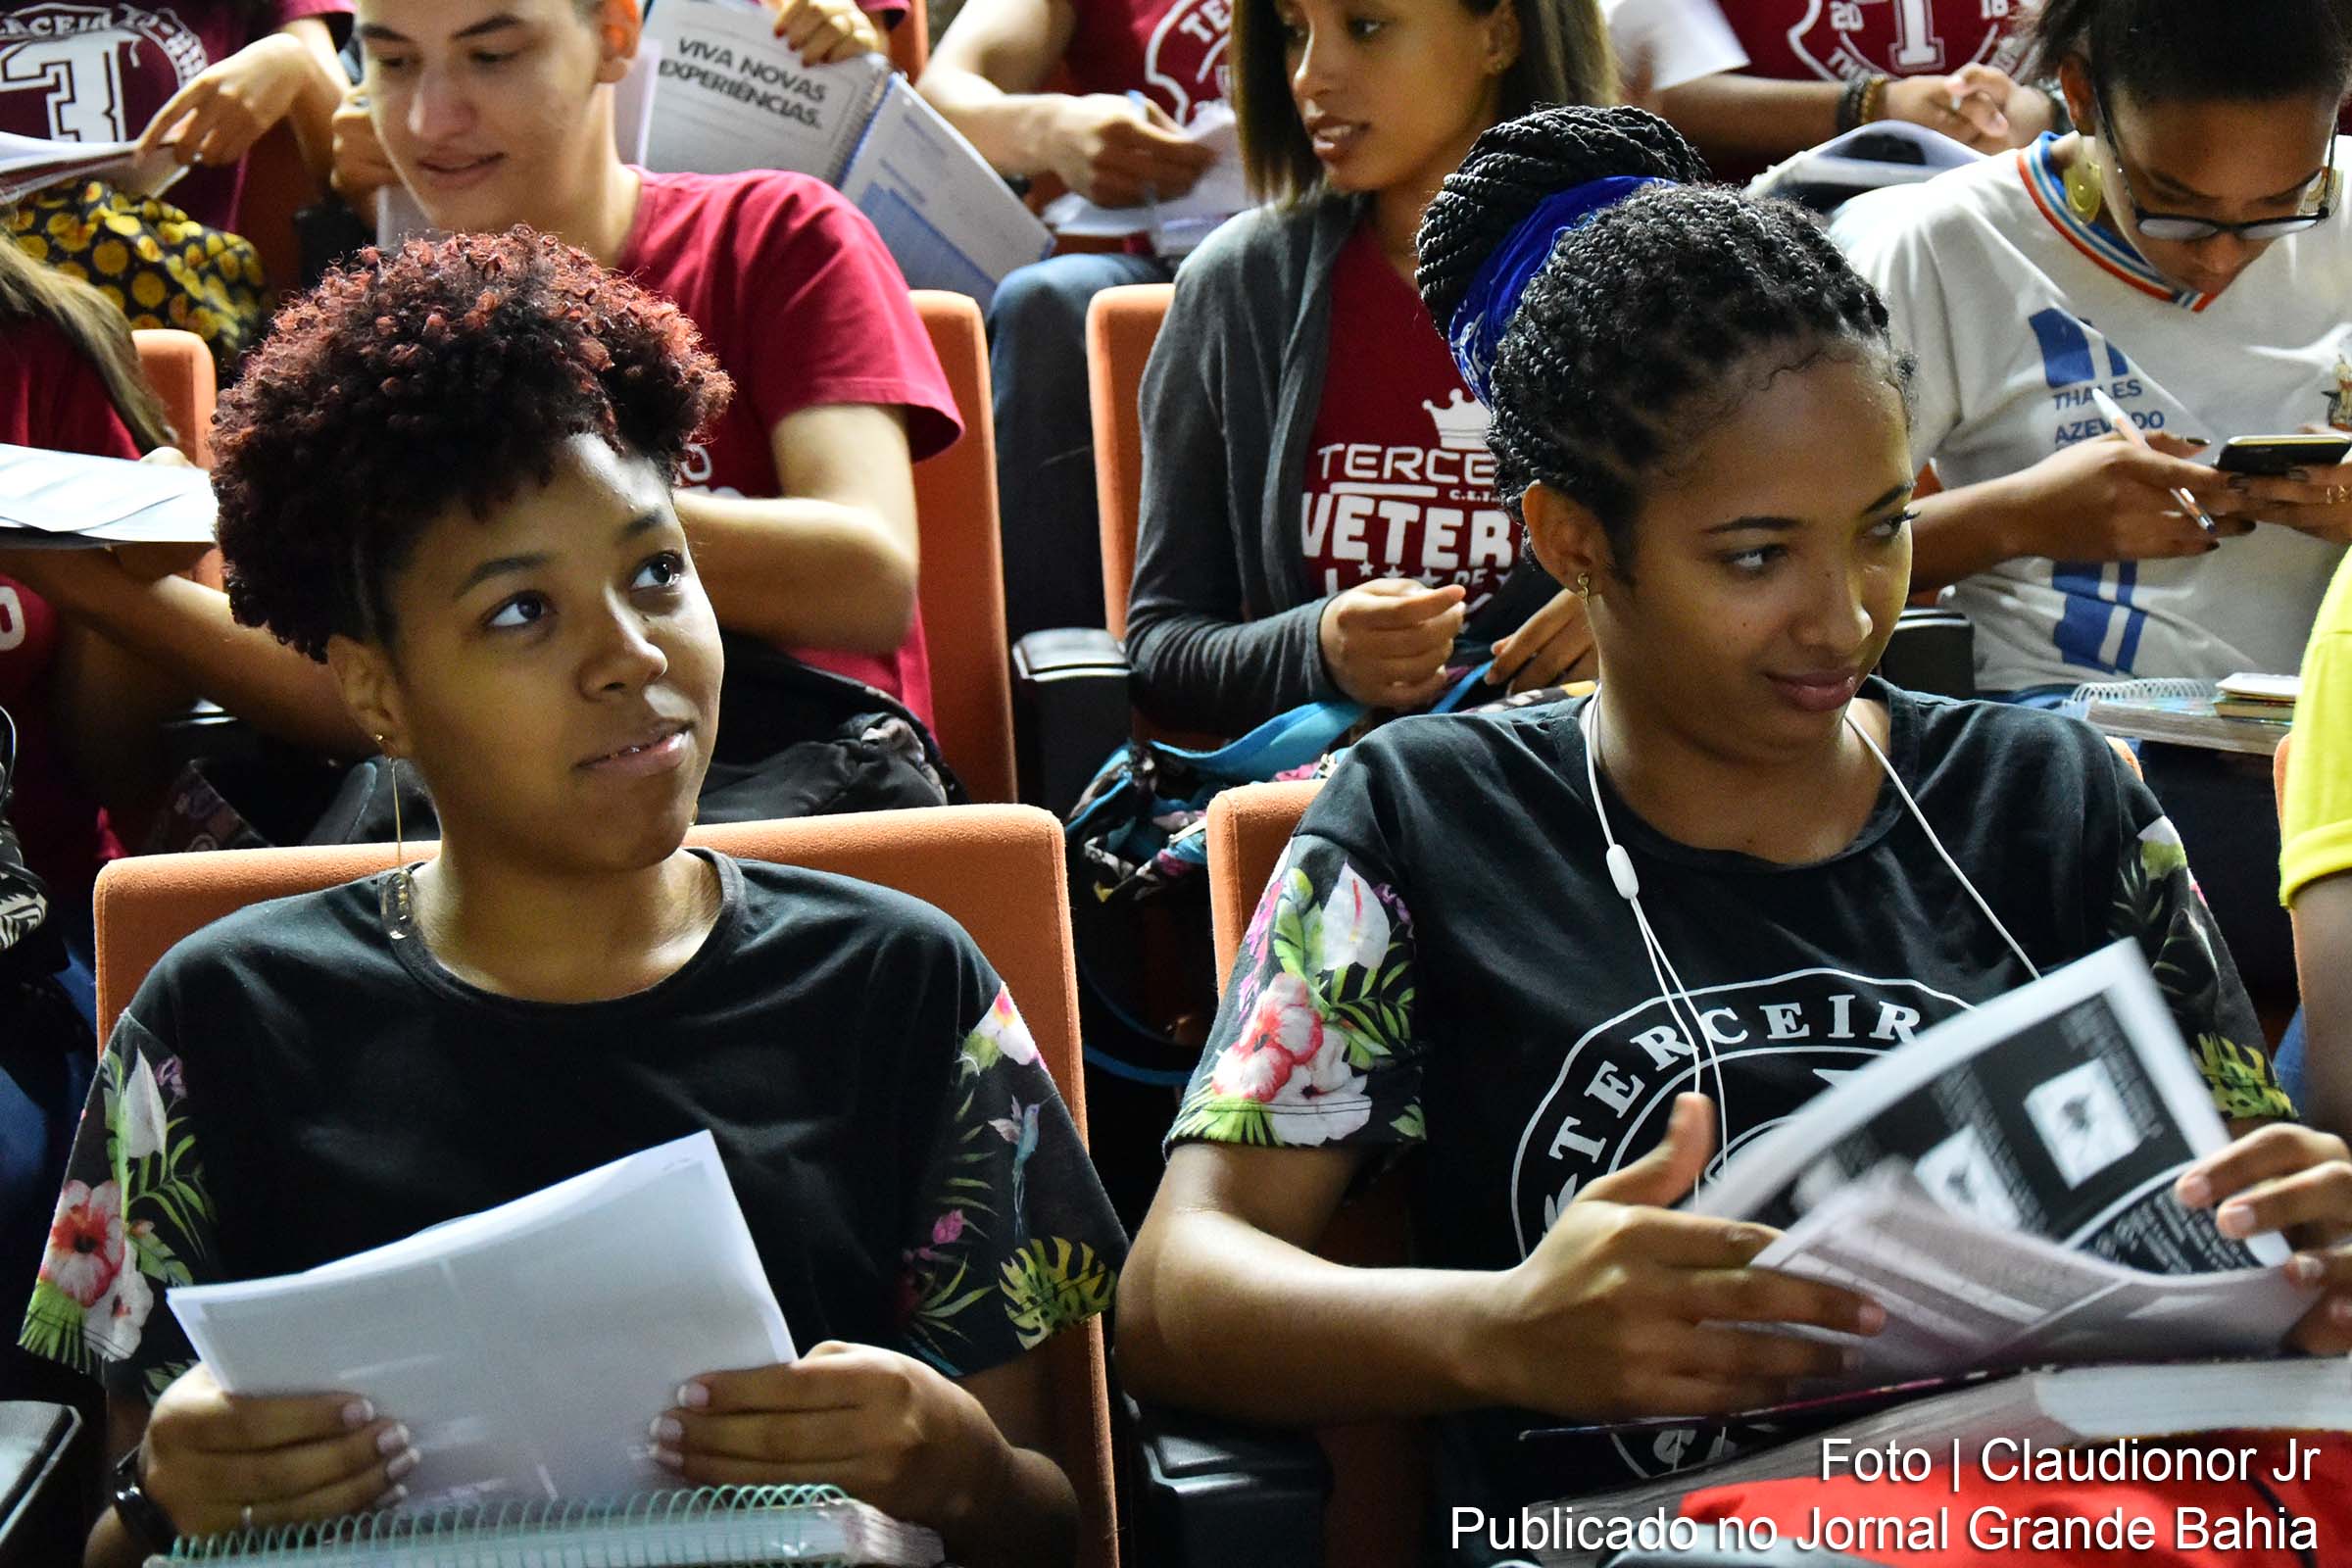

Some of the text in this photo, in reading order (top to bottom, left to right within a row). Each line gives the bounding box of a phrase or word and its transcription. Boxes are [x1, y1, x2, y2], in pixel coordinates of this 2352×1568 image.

[678, 37, 827, 103] VIVA NOVAS
[2055, 411, 2165, 447] AZEVDO
